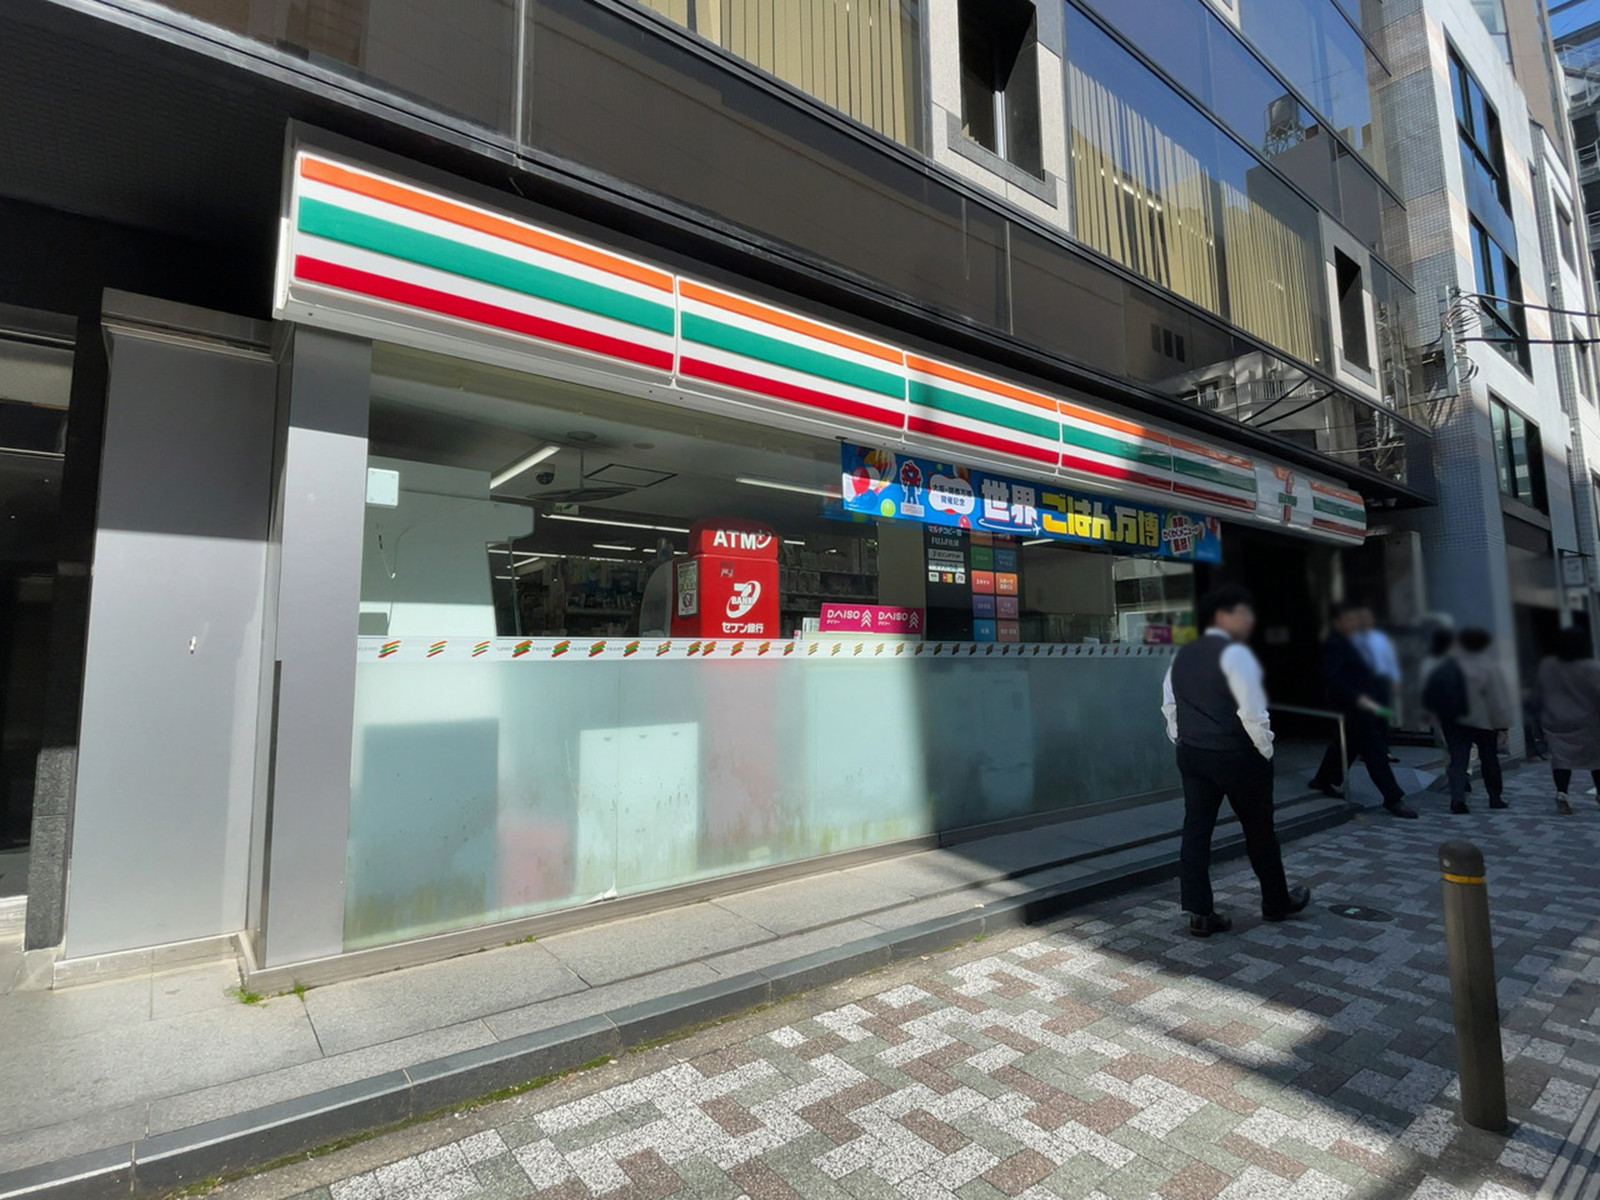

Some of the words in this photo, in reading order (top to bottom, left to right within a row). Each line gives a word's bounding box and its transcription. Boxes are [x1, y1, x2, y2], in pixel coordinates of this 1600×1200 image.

[713, 529, 757, 550] ATM
[931, 536, 960, 547] FUJIFILM
[827, 609, 860, 620] DAISO
[878, 611, 908, 621] DAISO
[721, 621, 764, 634] セブン銀行
